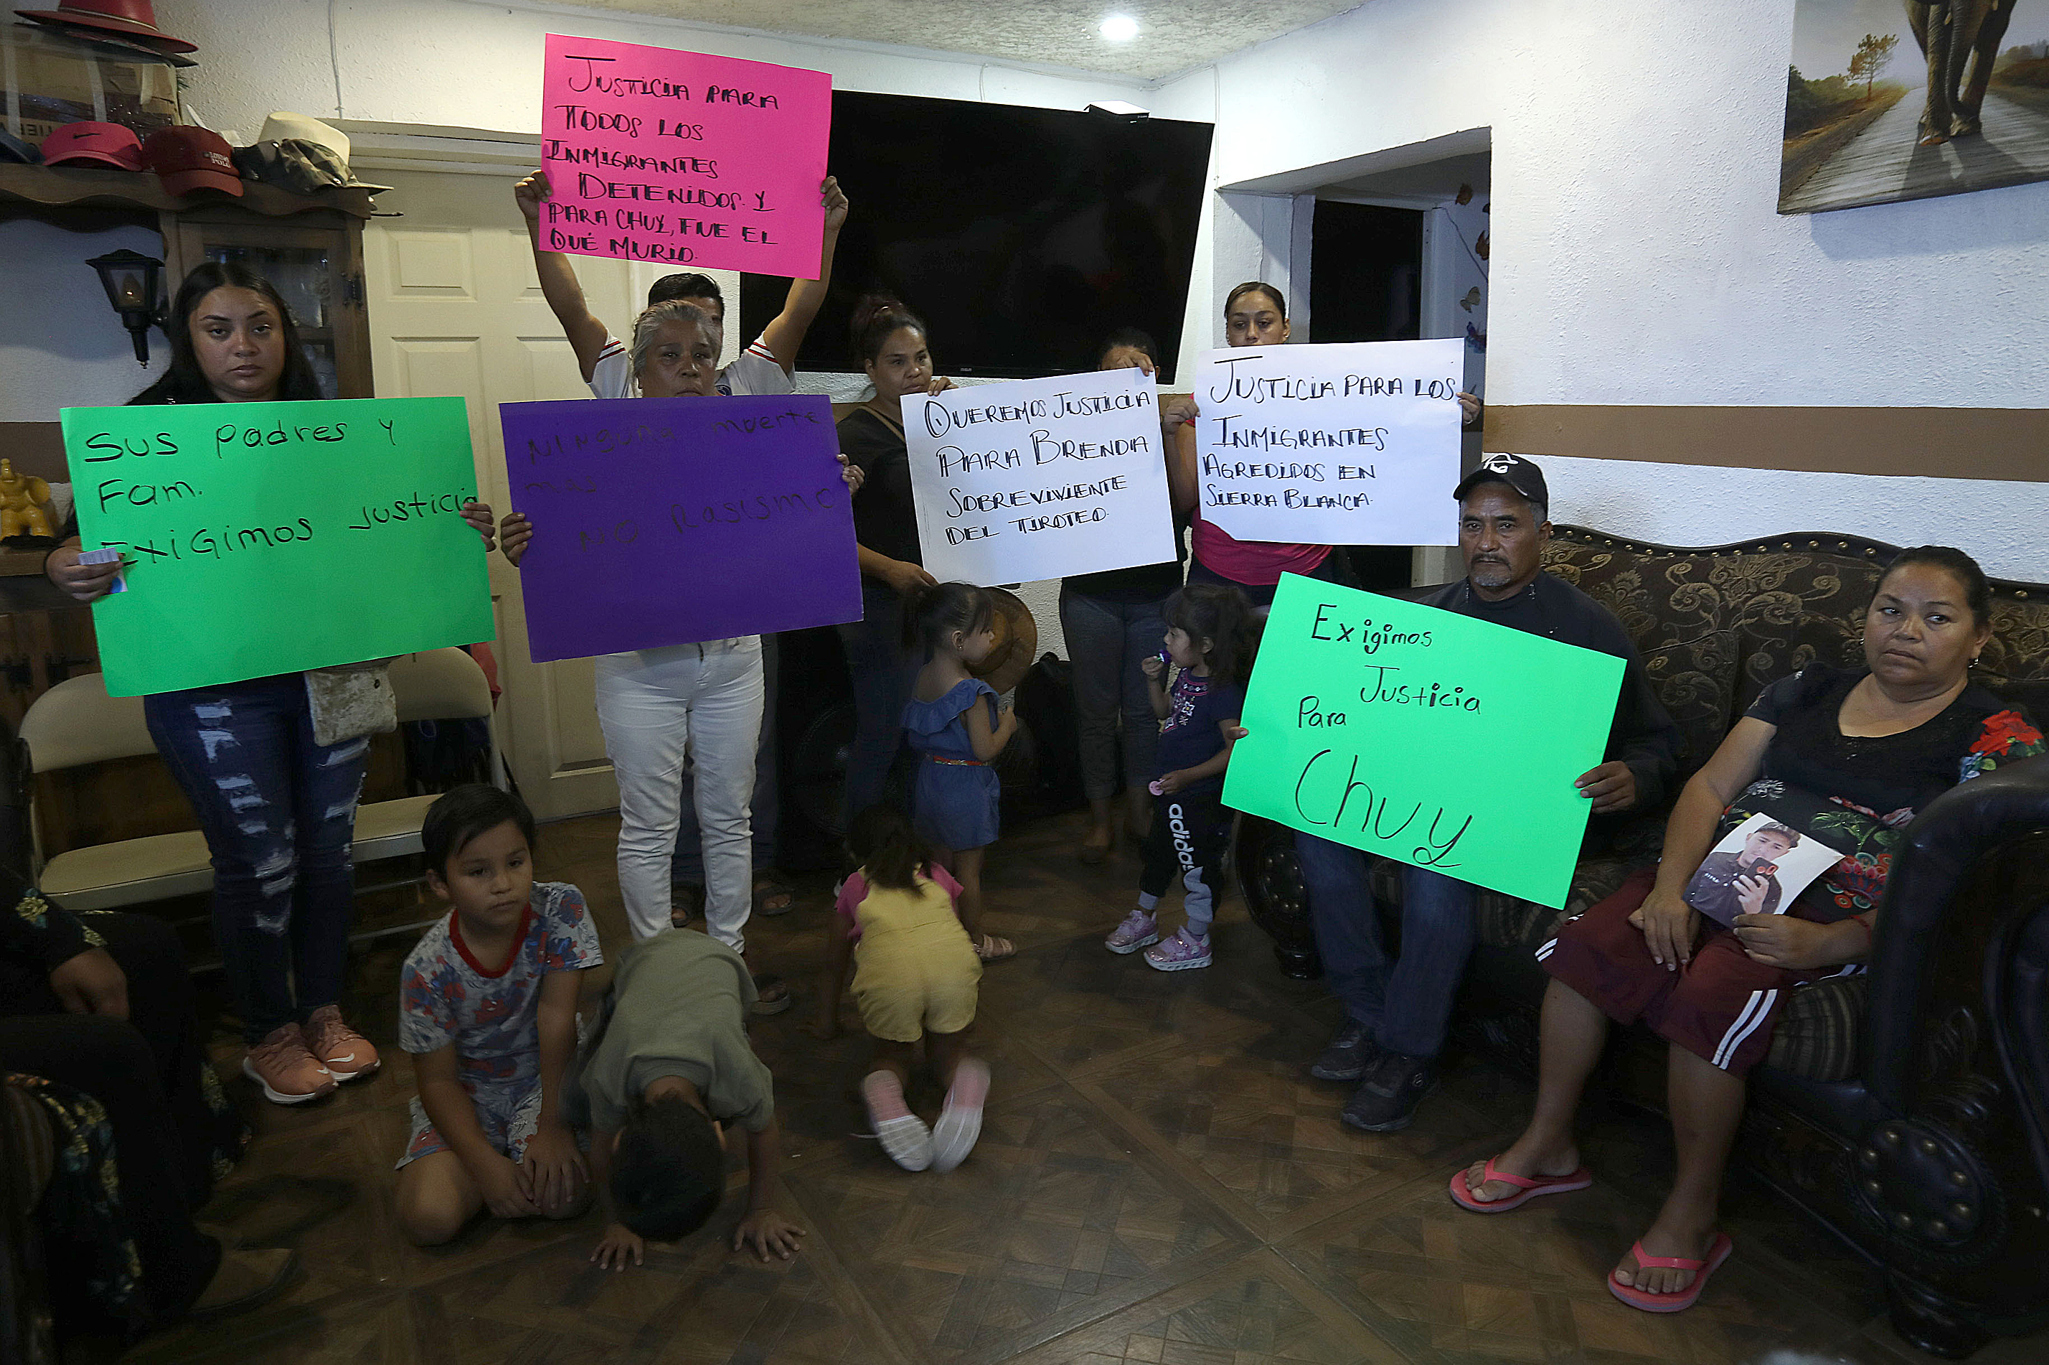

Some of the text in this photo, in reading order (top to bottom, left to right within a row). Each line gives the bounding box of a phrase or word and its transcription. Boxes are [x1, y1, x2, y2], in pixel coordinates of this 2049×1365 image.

[565, 55, 778, 109] JUSTICIA PARA
[554, 105, 703, 140] TODOS LOS
[545, 139, 718, 179] INMIGRANTES
[753, 191, 775, 212] Y
[549, 202, 778, 244] PARA CHUY, FUE EL
[1210, 355, 1456, 403] JUSTICIA PARA LOS
[924, 389, 1151, 438] QUEREMOS JUSTICIA
[1212, 414, 1389, 451] INMIGRANTES
[936, 429, 1149, 477] PARA BRENDA
[1202, 453, 1376, 482] AGREDIDOS EN
[99, 478, 202, 513] Fam.
[524, 473, 598, 495] mas
[946, 475, 1128, 518] SOBREVIVIENTE
[1205, 484, 1278, 507] SIERRA
[578, 518, 640, 552] NO
[945, 525, 1000, 546] DEL
[1311, 603, 1434, 654] Exigimos
[1360, 664, 1482, 715] Justicia
[1298, 695, 1348, 729] Para
[1295, 749, 1474, 868] Chuy
[1168, 803, 1196, 872] adidas
